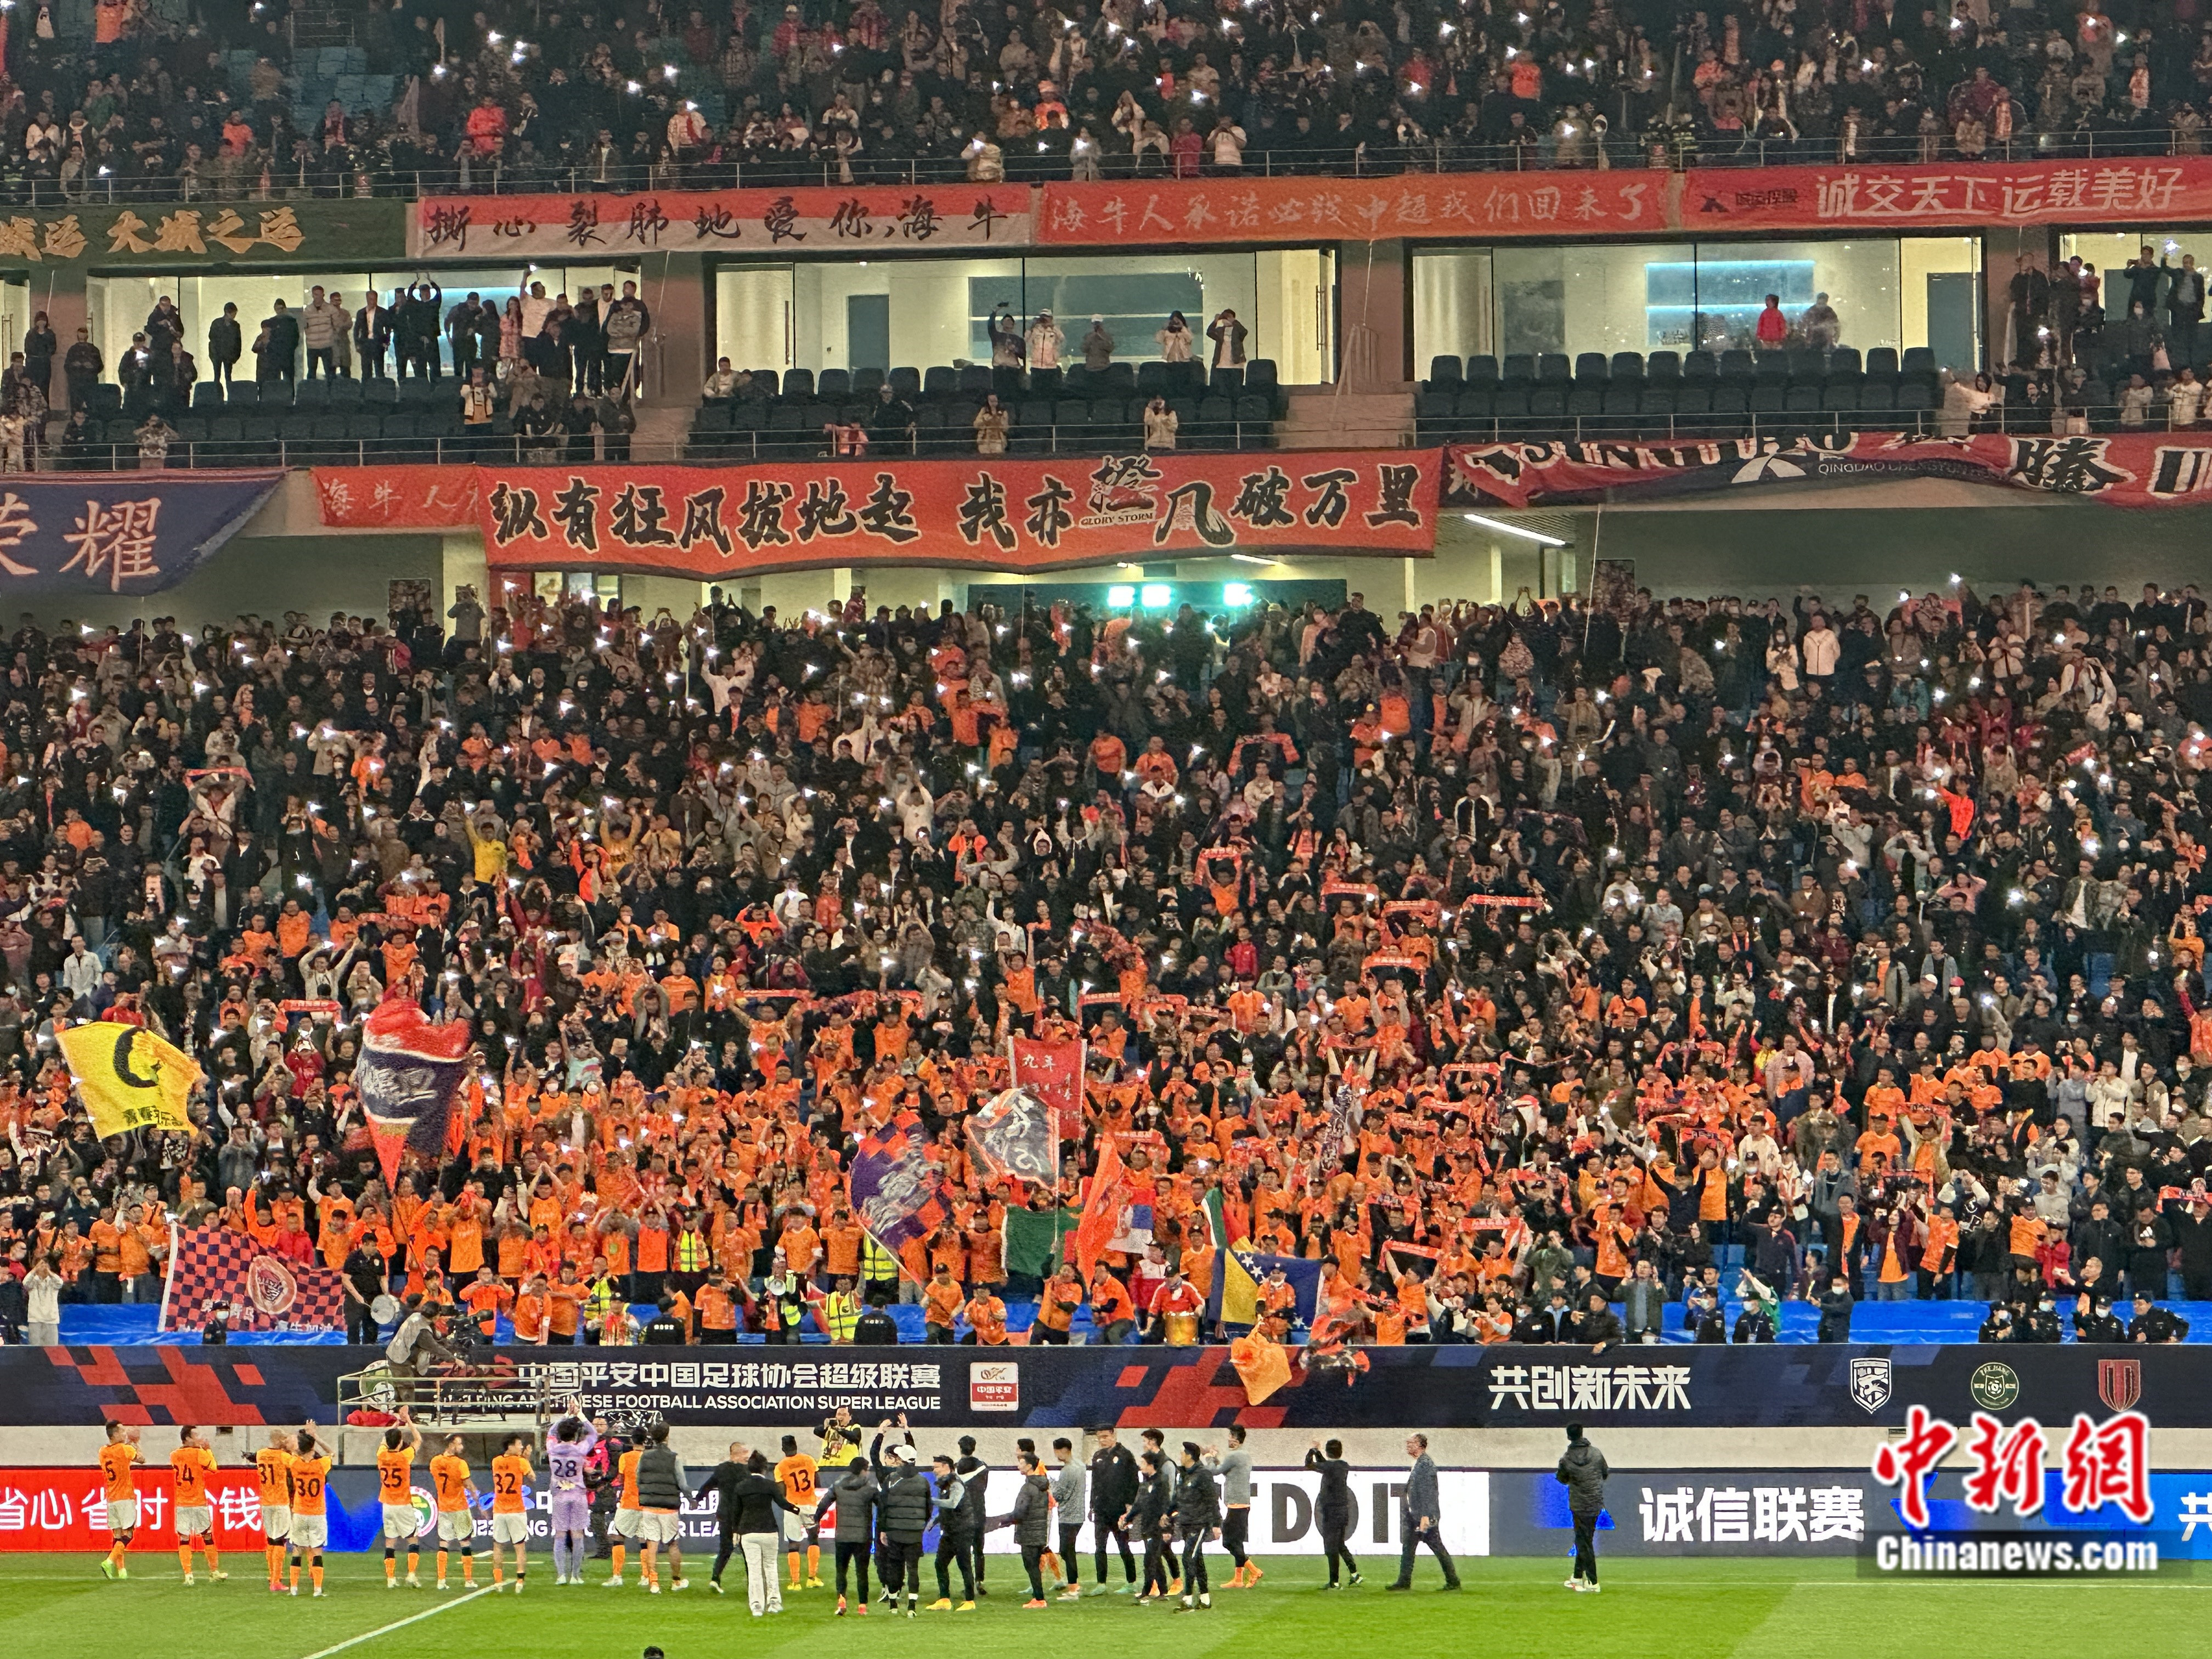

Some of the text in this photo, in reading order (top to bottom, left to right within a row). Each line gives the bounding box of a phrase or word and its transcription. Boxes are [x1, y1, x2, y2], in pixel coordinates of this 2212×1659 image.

[1118, 512, 1153, 523] STORM
[518, 1362, 941, 1389] 中国平安中国足球协会超级联赛
[1488, 1365, 1691, 1410] 共创新未来
[616, 1394, 702, 1409] FOOTBALL
[704, 1394, 815, 1409] ASSOCIATION
[818, 1395, 873, 1410] SUPER
[876, 1395, 940, 1410] LEAGUE
[380, 1468, 403, 1488] 25
[552, 1459, 577, 1479] 28
[296, 1477, 320, 1497] 30
[438, 1472, 448, 1494] 7
[494, 1472, 517, 1494] 32
[789, 1469, 811, 1493] 13
[1639, 1486, 1865, 1543] 诚信联赛
